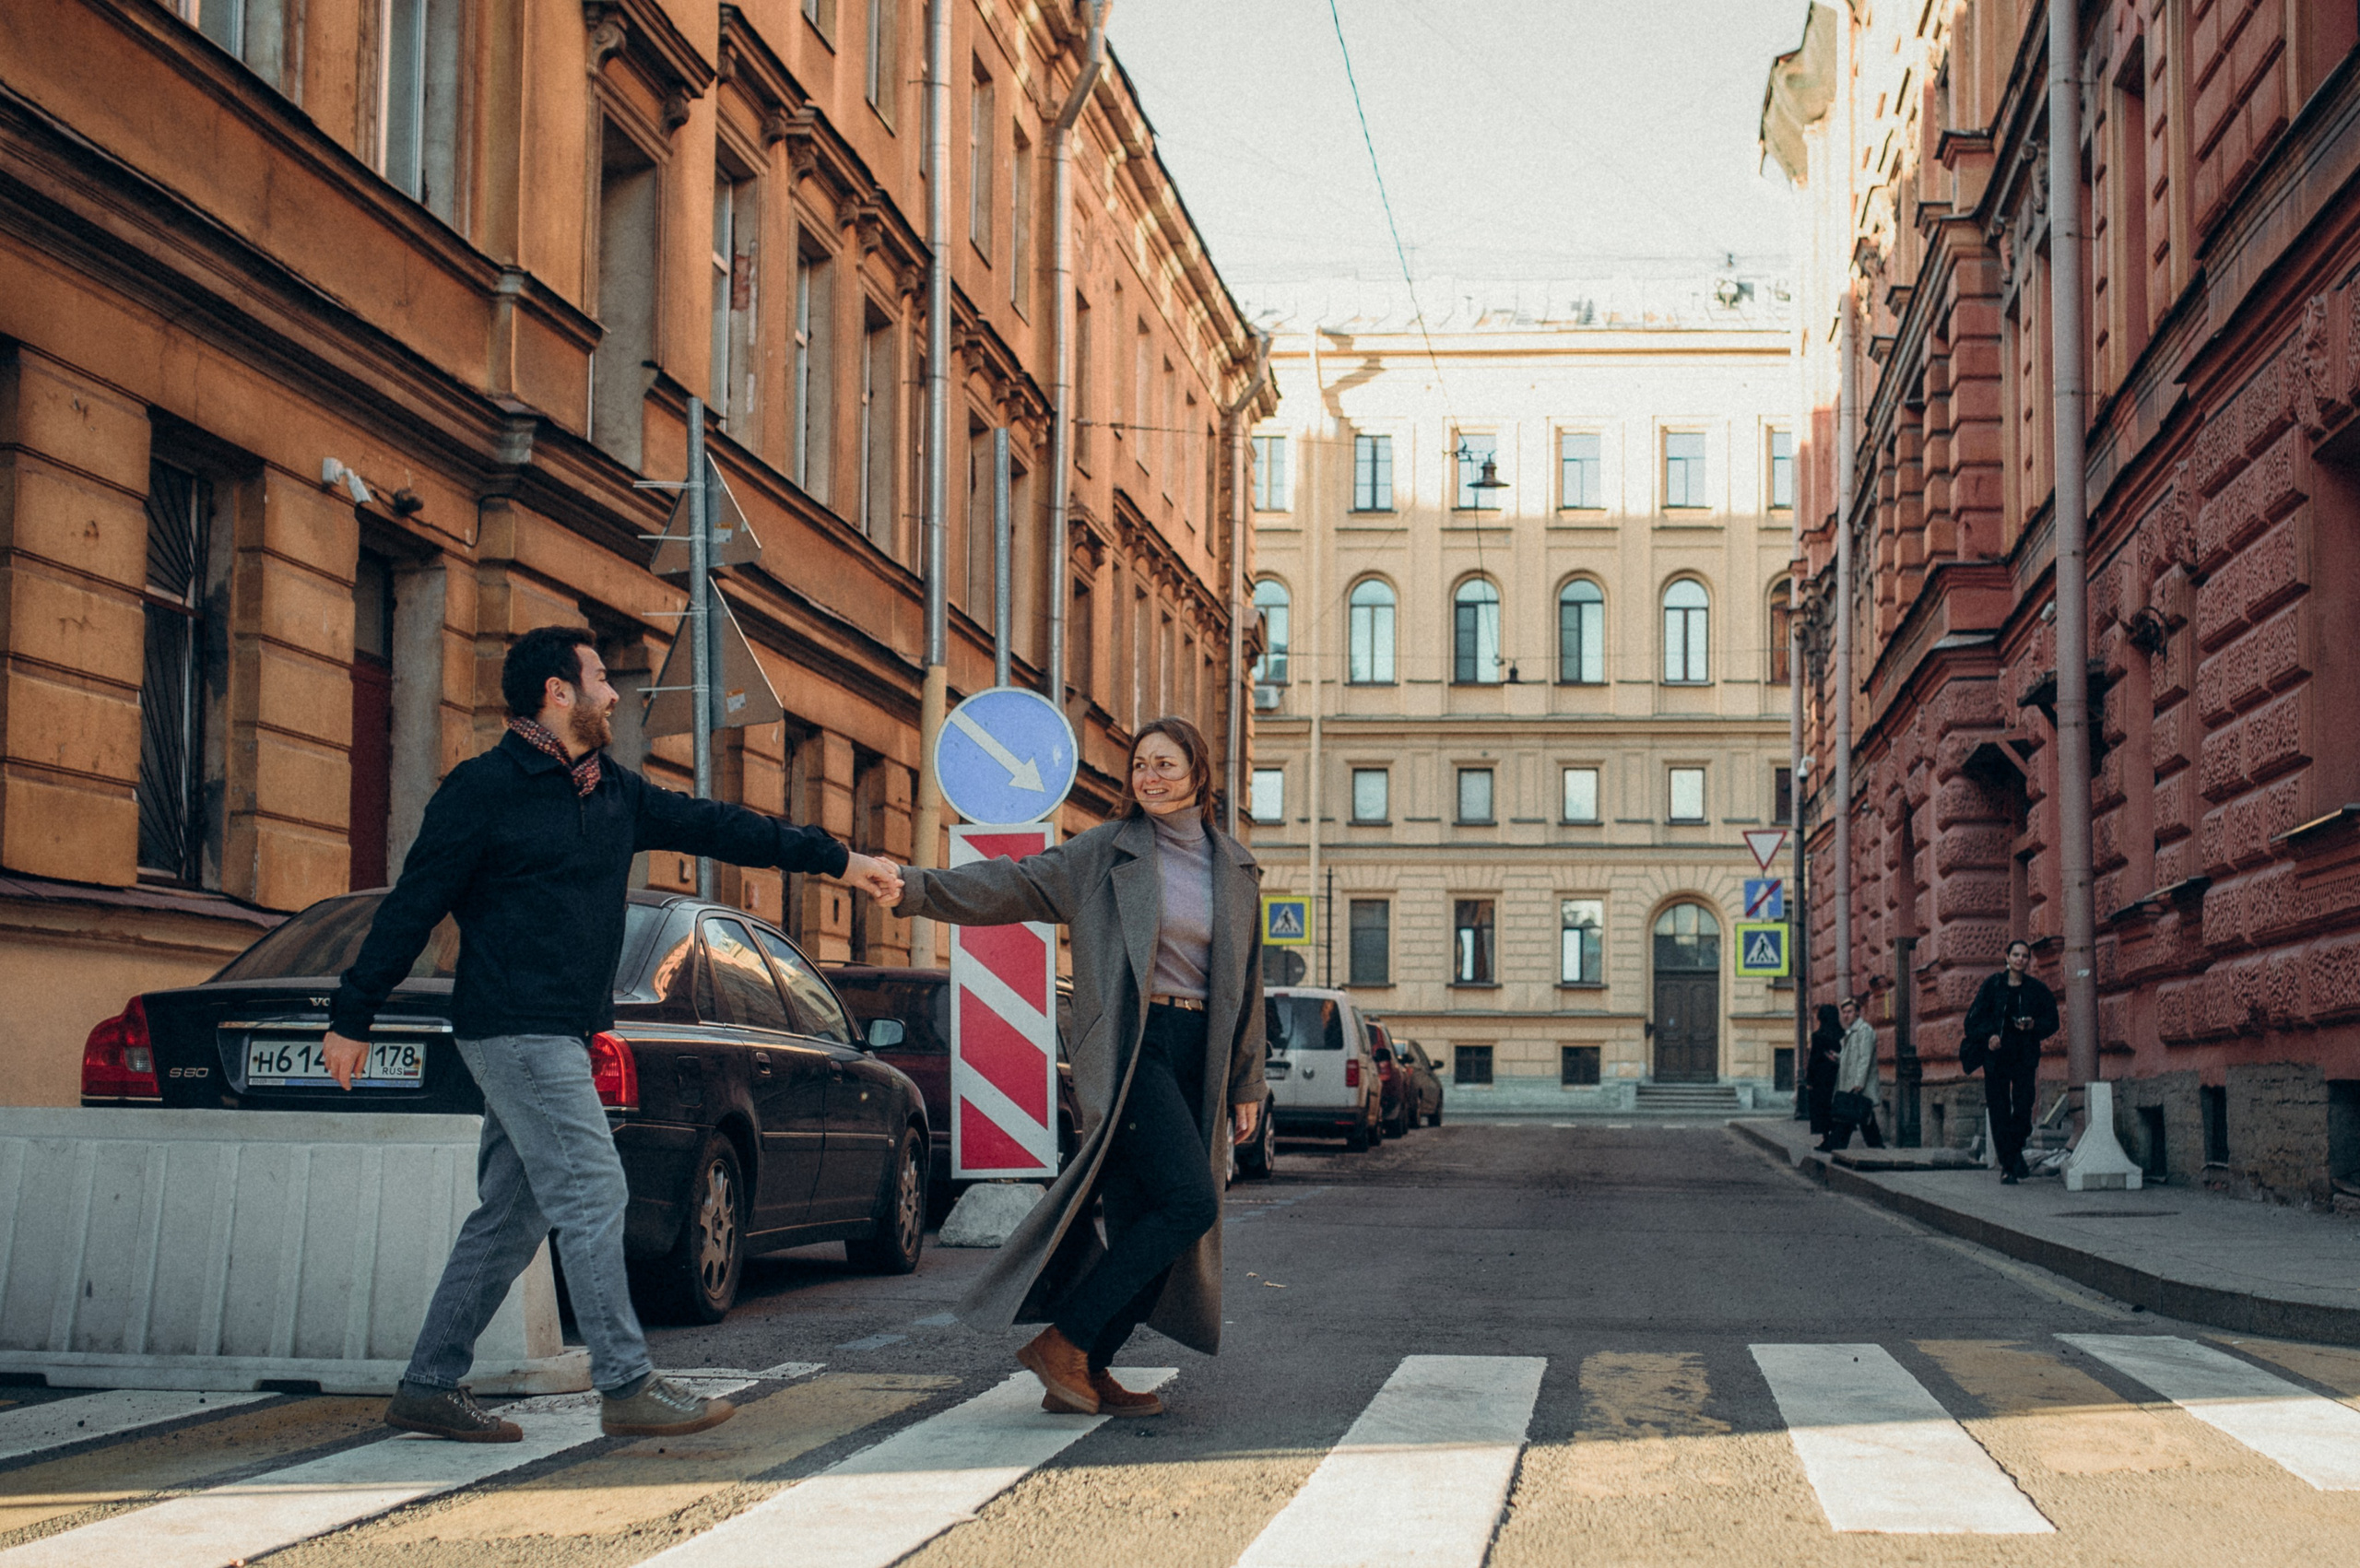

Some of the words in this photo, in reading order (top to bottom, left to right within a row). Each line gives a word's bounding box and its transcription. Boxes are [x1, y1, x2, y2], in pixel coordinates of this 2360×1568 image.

[257, 1044, 366, 1074] Н614
[374, 1045, 416, 1067] 178
[382, 1067, 403, 1076] RUS
